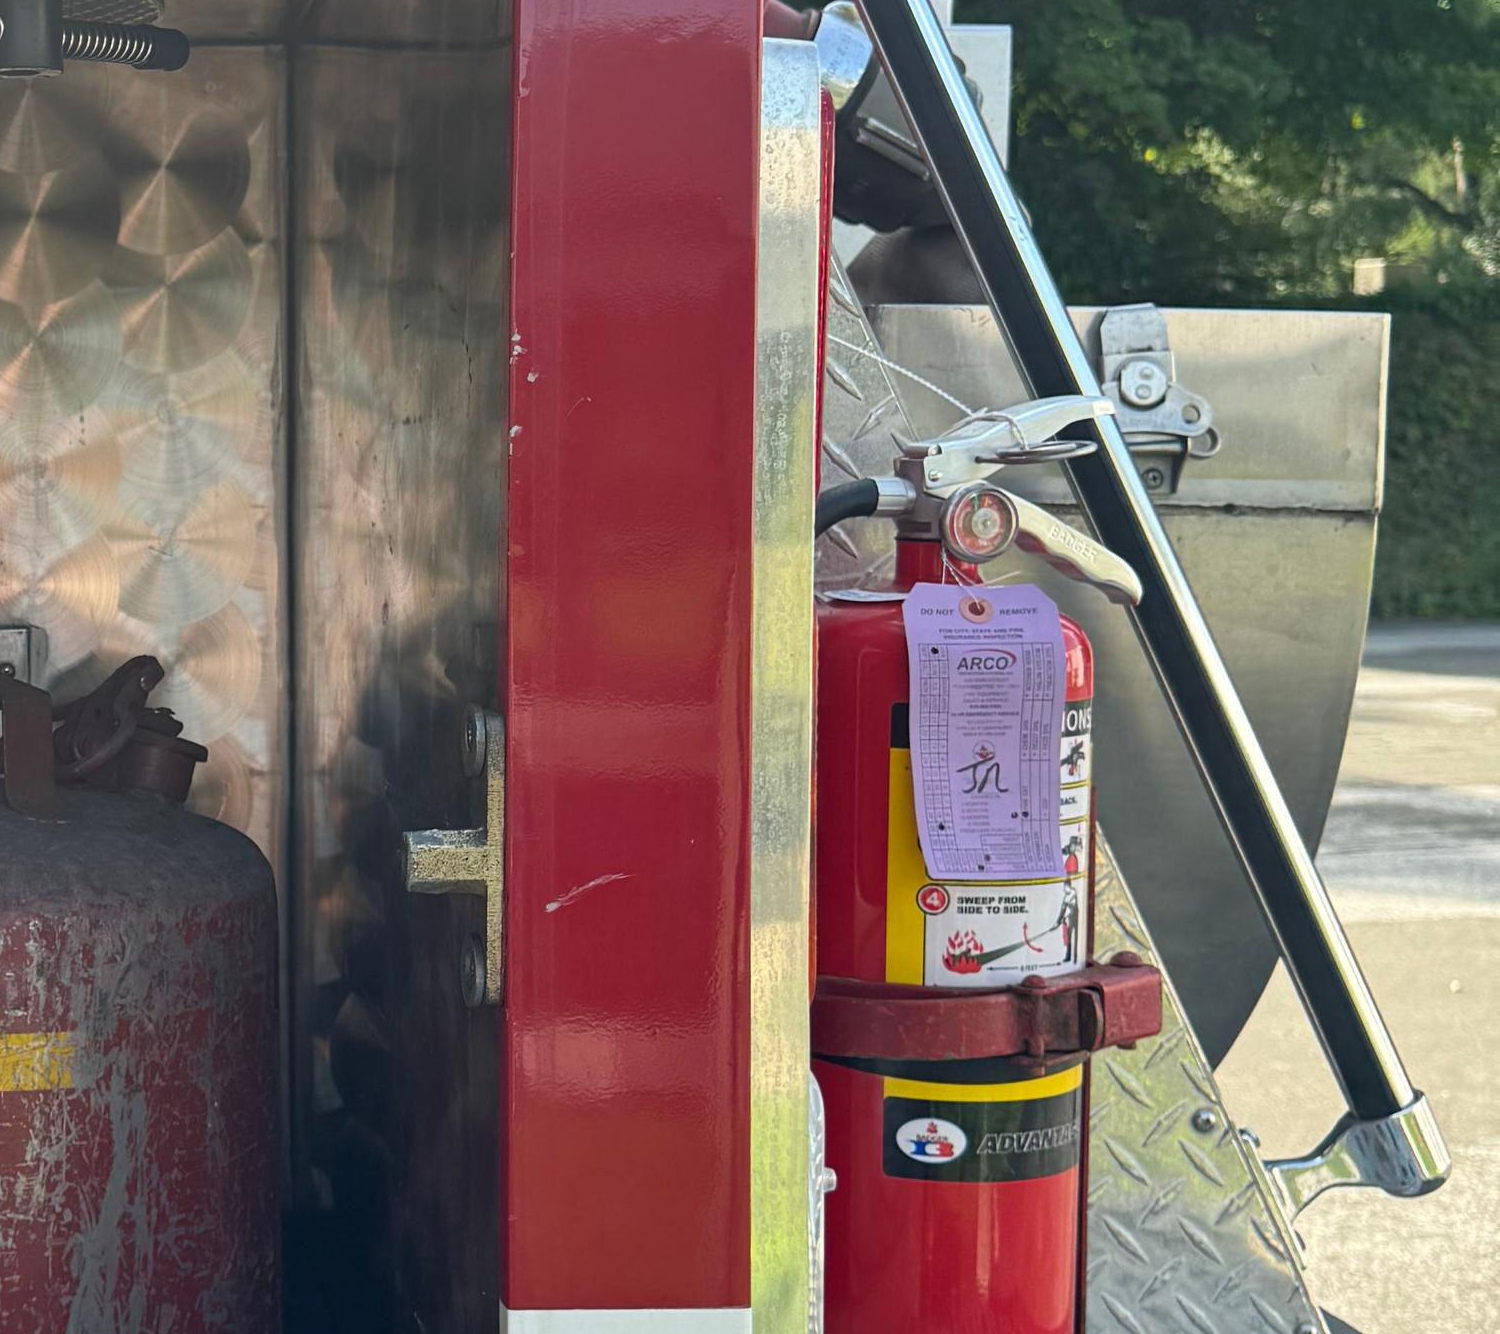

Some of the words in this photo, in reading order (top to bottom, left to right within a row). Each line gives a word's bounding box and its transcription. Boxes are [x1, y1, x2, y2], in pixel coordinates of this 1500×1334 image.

[1048, 524, 1098, 564] BADGER
[920, 608, 934, 616] DO
[999, 607, 1038, 616] REMOVE
[956, 656, 1009, 671] ARCO
[926, 891, 941, 908] 4
[956, 896, 995, 905] SWEEP
[998, 896, 1026, 905] FROM
[956, 906, 985, 914] SIDE
[985, 906, 1000, 914] TO
[1003, 905, 1029, 914] SIDE.
